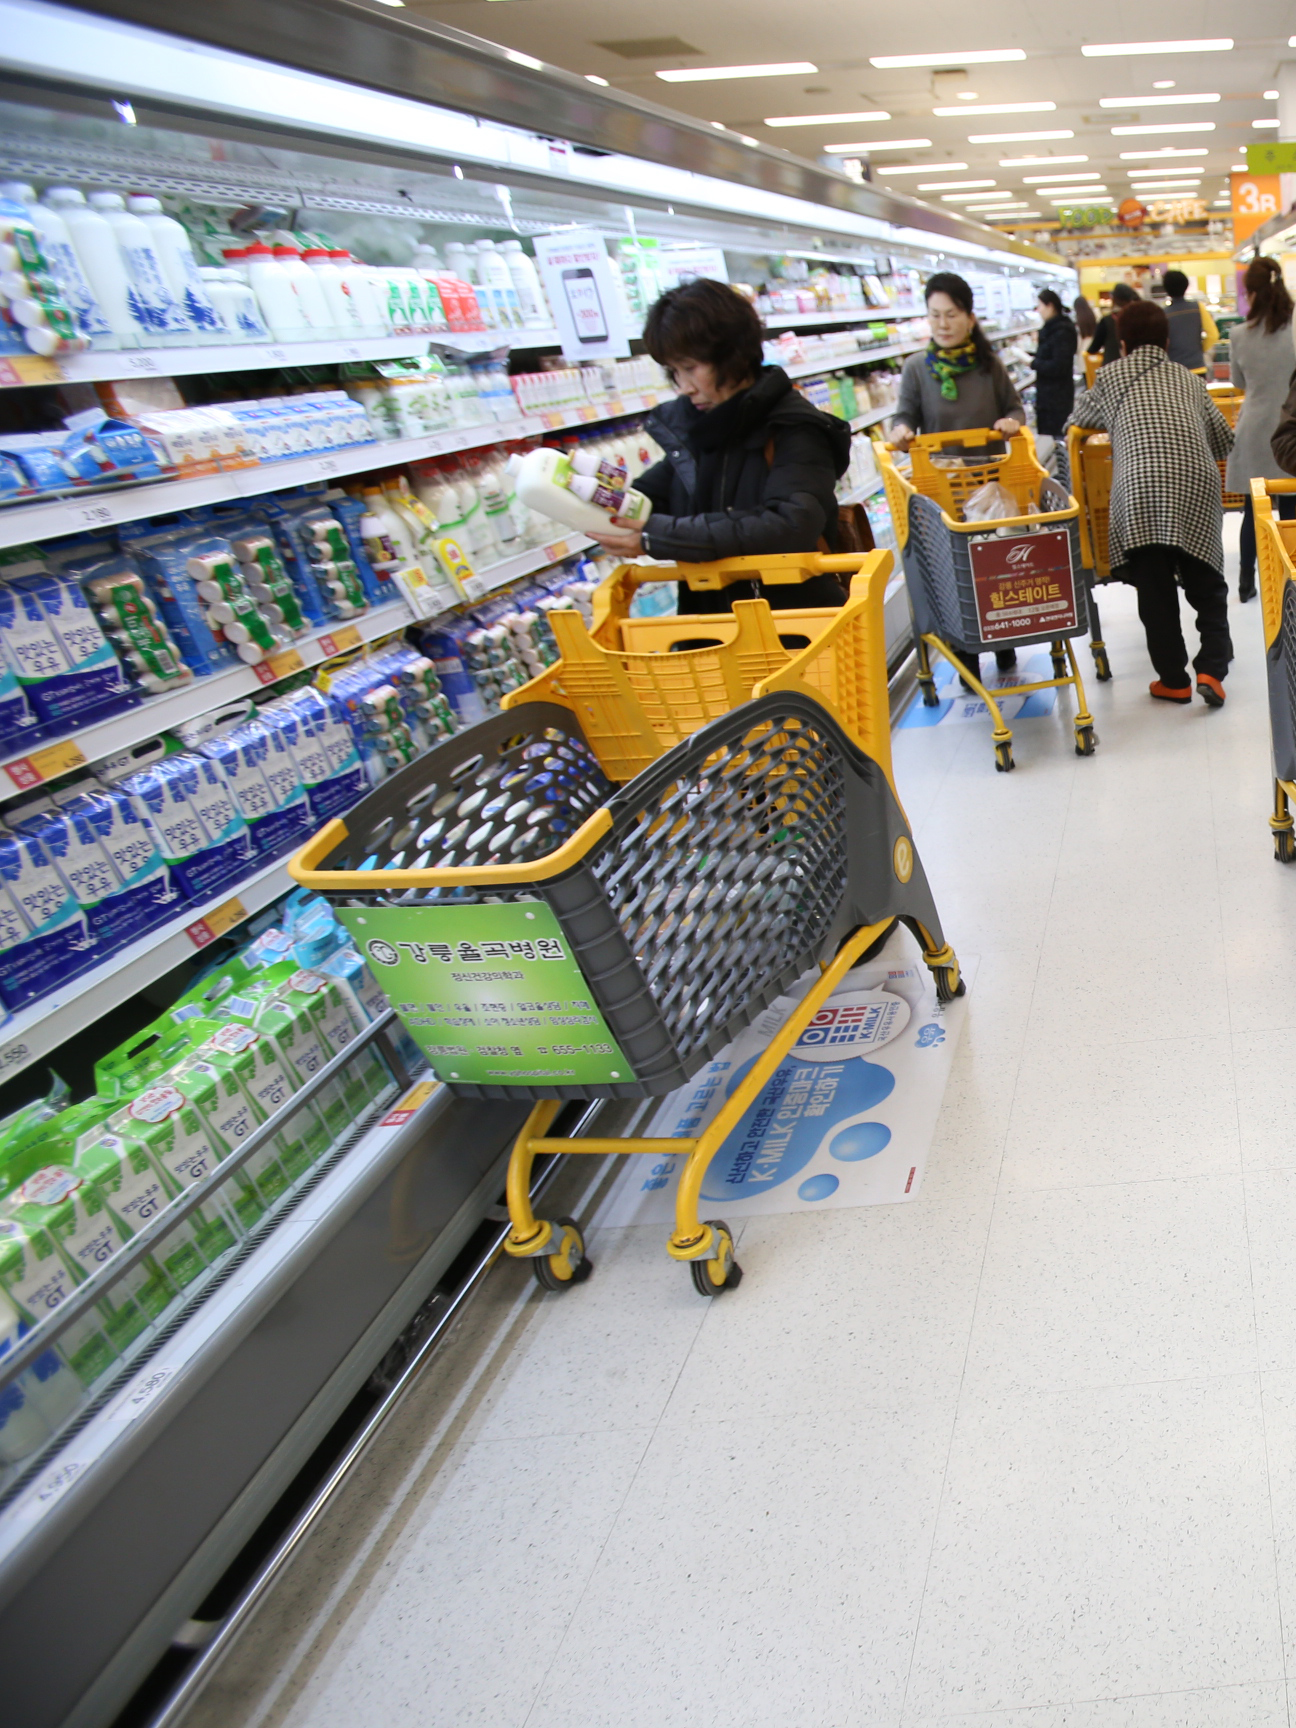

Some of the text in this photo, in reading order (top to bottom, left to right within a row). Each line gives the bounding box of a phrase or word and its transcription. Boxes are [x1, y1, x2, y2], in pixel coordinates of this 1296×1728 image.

[990, 584, 1062, 609] 힐스테이트
[16, 638, 58, 666] 맛있는
[33, 658, 60, 674] 우유
[249, 798, 270, 813] 우유
[164, 818, 201, 840] 맛있는
[174, 835, 201, 853] 우유
[114, 842, 154, 868] 맛있는
[69, 860, 109, 886] 맛있는
[23, 883, 65, 909] 맛있는
[85, 879, 113, 897] 우유
[451, 971, 524, 982] 정신건강의학과
[338, 1026, 350, 1044] GT
[307, 1056, 320, 1072] GT
[269, 1086, 286, 1104] GT
[777, 1067, 819, 1119] 인증마크
[804, 1065, 844, 1118] 확인하기
[232, 1118, 249, 1137] GT
[726, 1140, 760, 1185] 신선하고
[748, 1108, 775, 1139] 안전한
